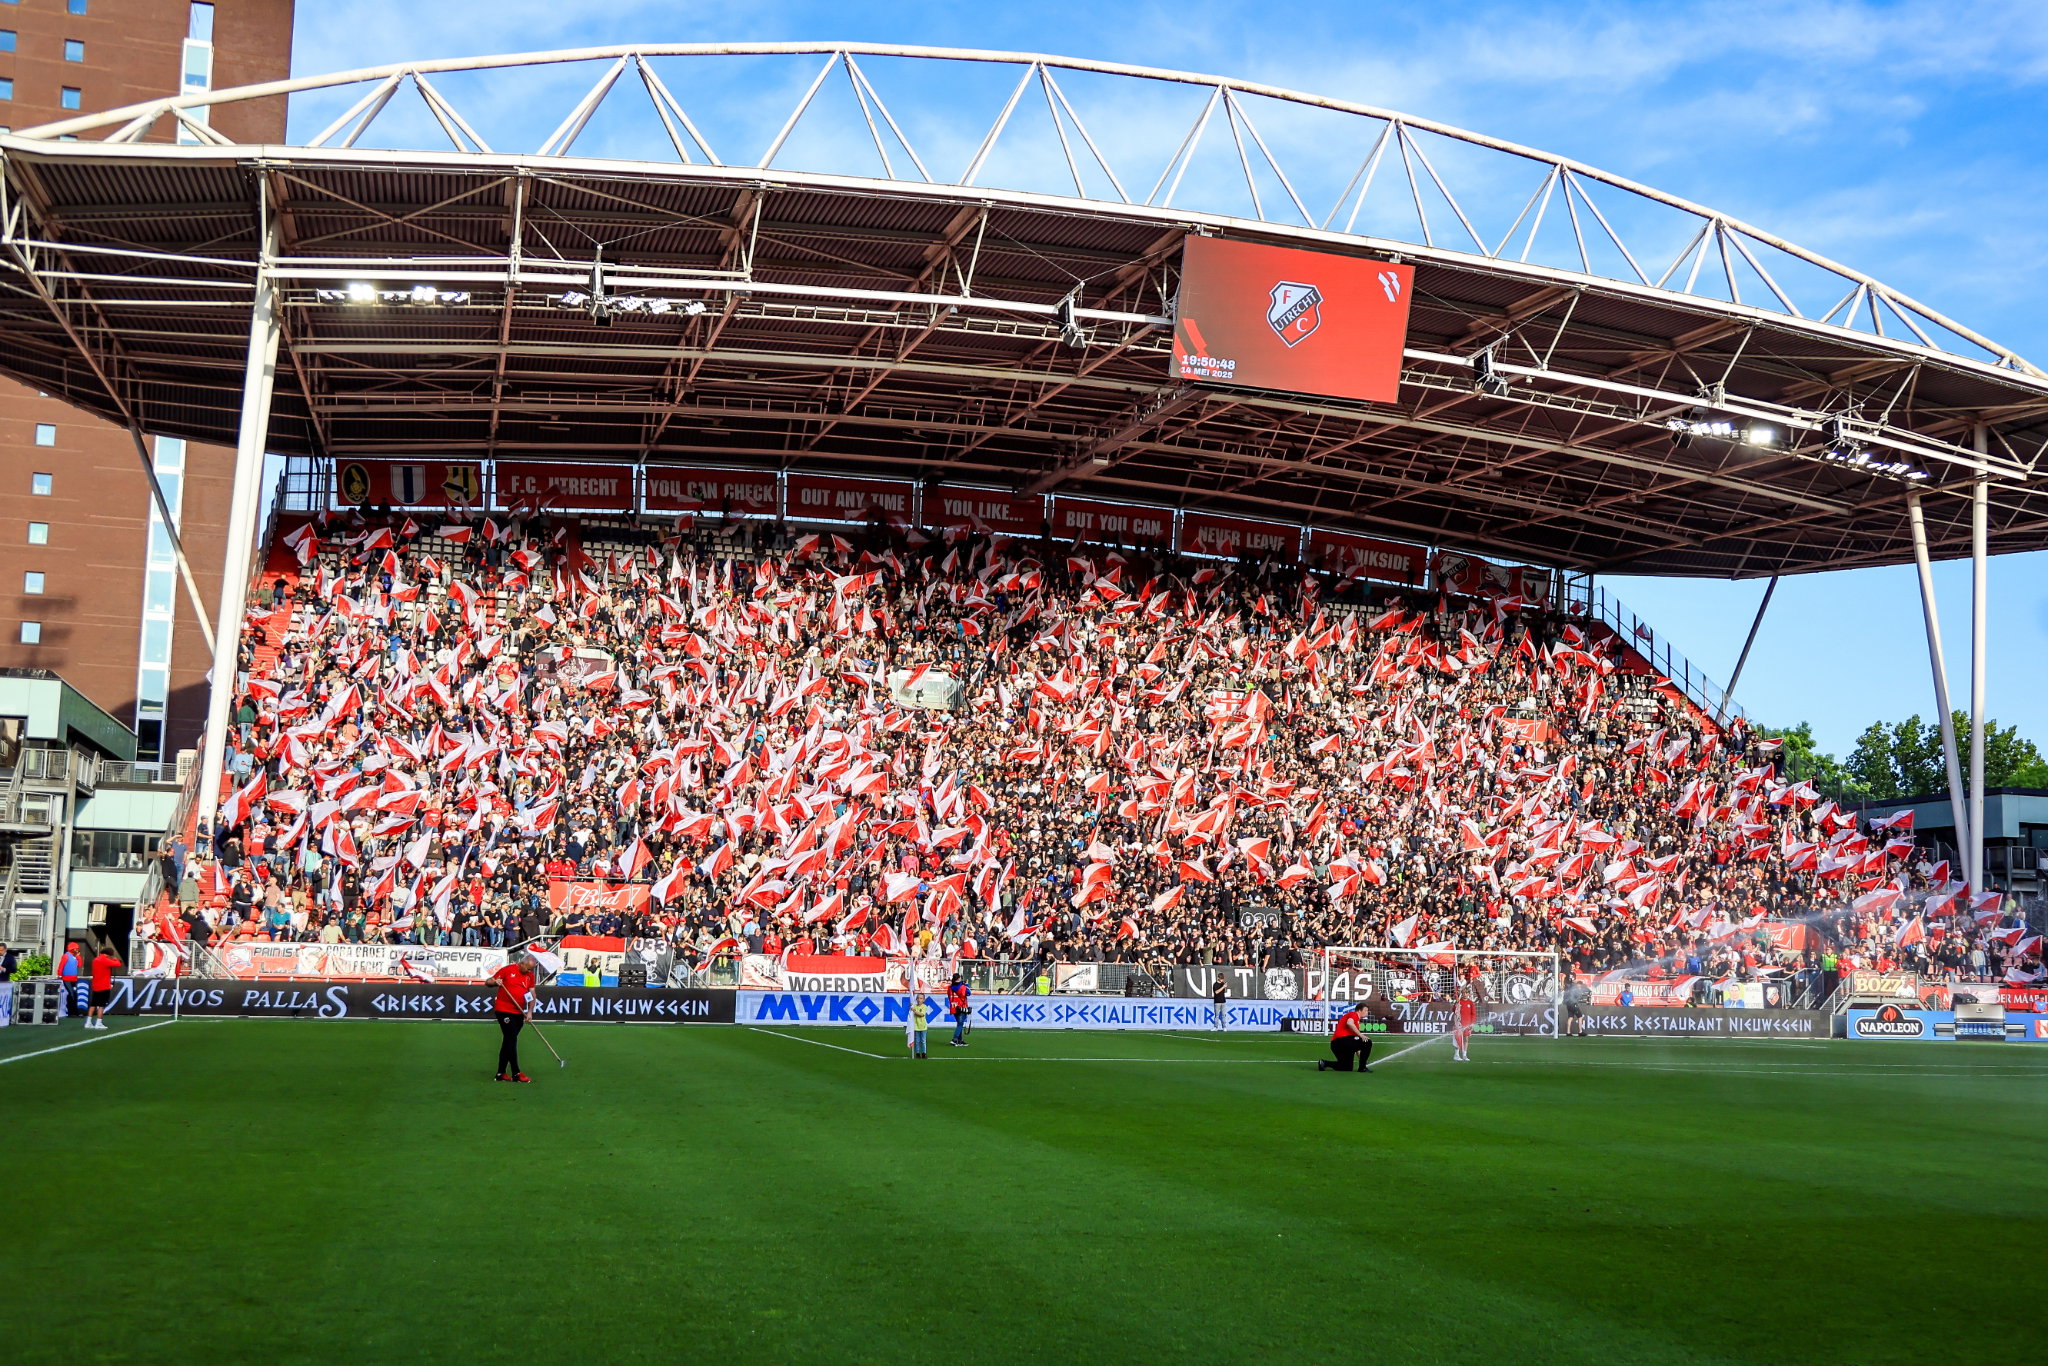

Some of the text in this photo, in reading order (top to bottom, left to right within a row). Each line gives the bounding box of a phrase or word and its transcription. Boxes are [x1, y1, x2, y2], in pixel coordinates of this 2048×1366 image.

[1282, 289, 1292, 305] F
[1274, 291, 1317, 331] UTRECHT
[1296, 317, 1309, 332] C
[1181, 354, 1236, 370] 19:50:48
[1193, 367, 1210, 376] MEI
[511, 475, 542, 494] F.C.
[649, 479, 681, 497] YOU
[723, 483, 774, 502] CHECK
[801, 487, 905, 511] OUT ANY TIME
[943, 498, 1024, 522] YOU LIKE...
[1065, 510, 1161, 536] BUT YOU CAN
[1198, 526, 1286, 552] NEVER LEAVE
[574, 885, 622, 906] Bud
[253, 946, 281, 958] PAIN
[633, 937, 668, 955] 033
[425, 951, 483, 962] FOREVER
[788, 975, 886, 993] WOERDEN
[103, 978, 349, 1018] MINOS PALLAS
[371, 993, 710, 1017] GRIEKS RESRANT NIEUWEGEIN
[977, 1003, 1320, 1027] GRIEKS SPECIALITEITEN RSTAURANT
[1634, 1014, 1723, 1032] RESTAURANT
[1729, 1016, 1812, 1033] NIEUWEGEIN
[1403, 1021, 1448, 1034] UNIBET
[1859, 1021, 1920, 1034] NAPOLEON
